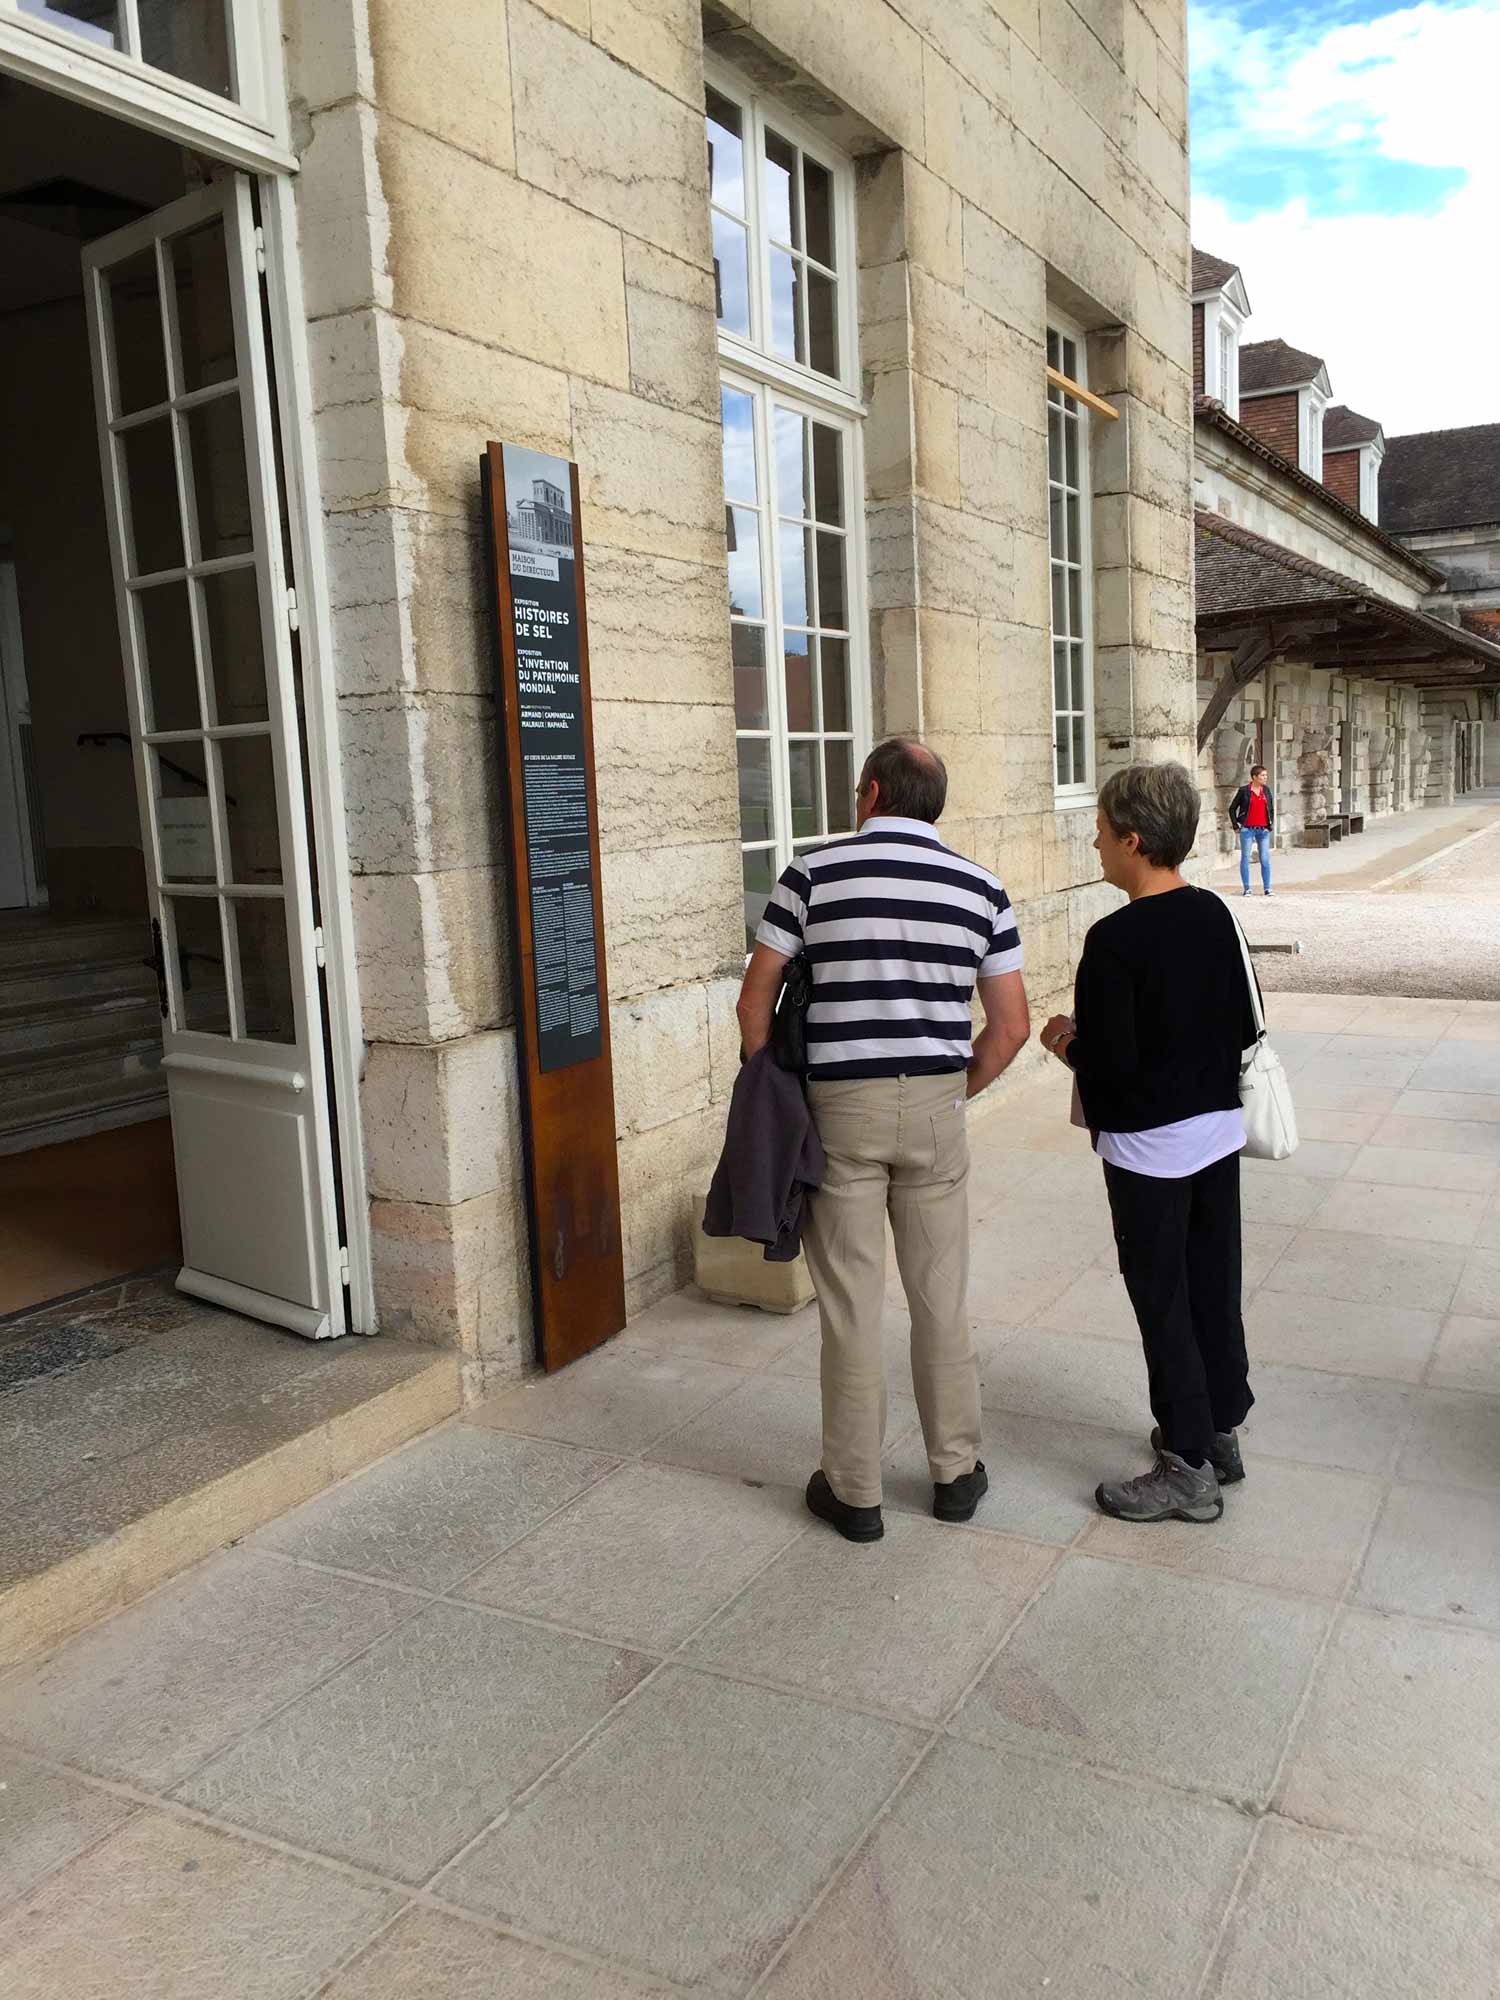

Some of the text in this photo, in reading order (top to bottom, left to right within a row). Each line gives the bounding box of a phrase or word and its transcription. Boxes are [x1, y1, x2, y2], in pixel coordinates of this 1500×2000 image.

[512, 553, 535, 565] MAISON
[512, 563, 555, 577] DU DIRECTEUR
[514, 606, 569, 625] HISTOIRES
[516, 622, 552, 639] DE SEL
[518, 656, 569, 671] L'INVENTION
[518, 670, 580, 683] DU PATRIMOINE
[519, 683, 556, 694] MONDIAL
